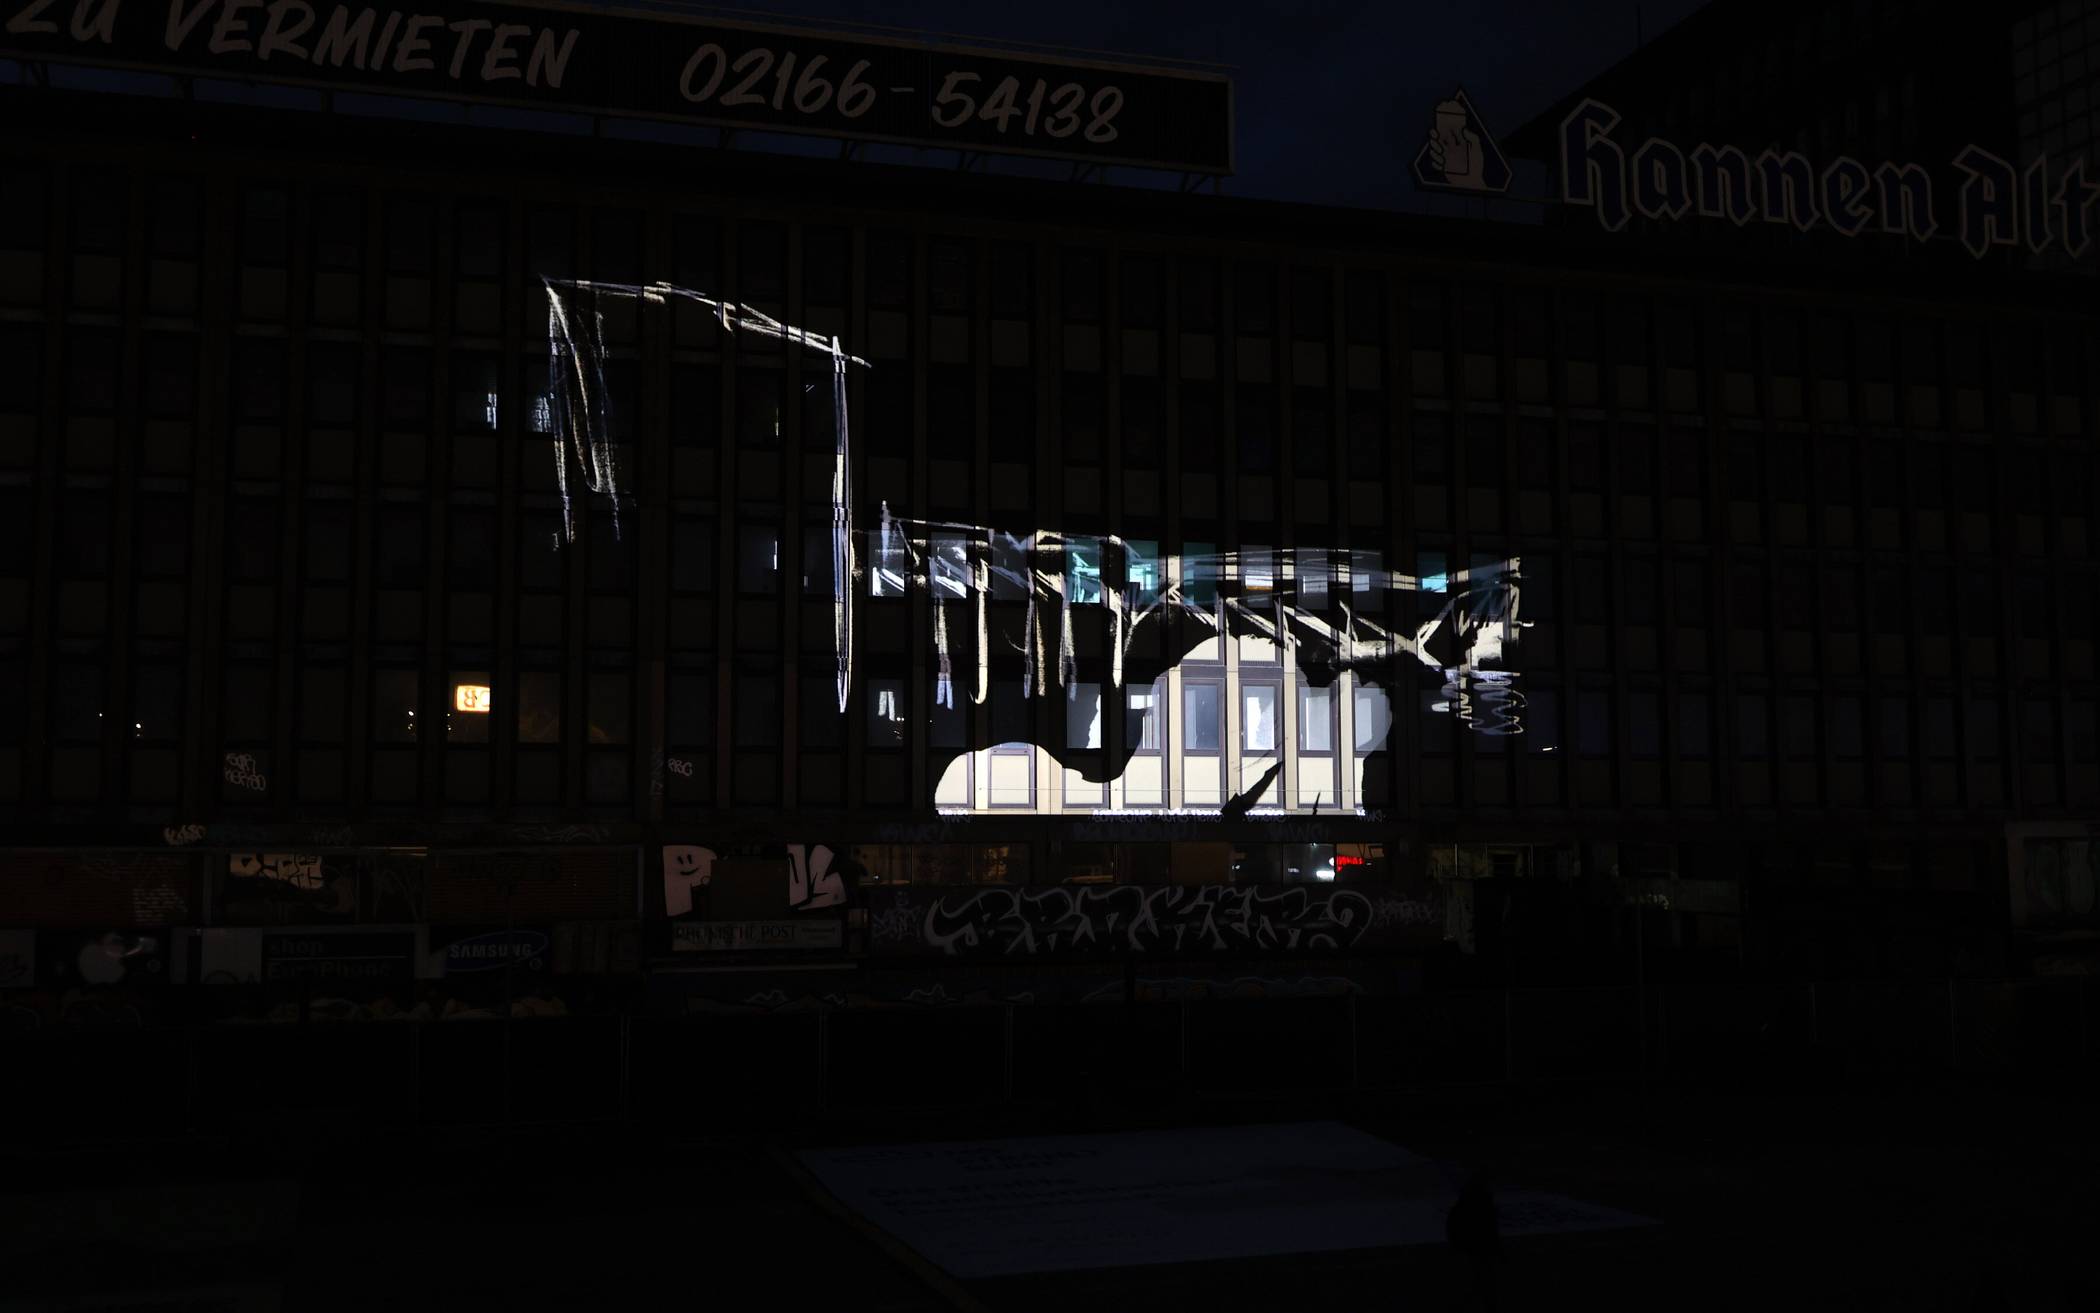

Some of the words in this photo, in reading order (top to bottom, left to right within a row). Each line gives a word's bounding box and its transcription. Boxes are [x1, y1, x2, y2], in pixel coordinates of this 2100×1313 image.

[6, 0, 119, 45] ZU
[163, 0, 580, 88] VERMIETEN
[679, 42, 878, 119] 02166
[930, 71, 1125, 144] 54138
[1951, 143, 2100, 261] Alt
[447, 943, 532, 960] SAMSUNG
